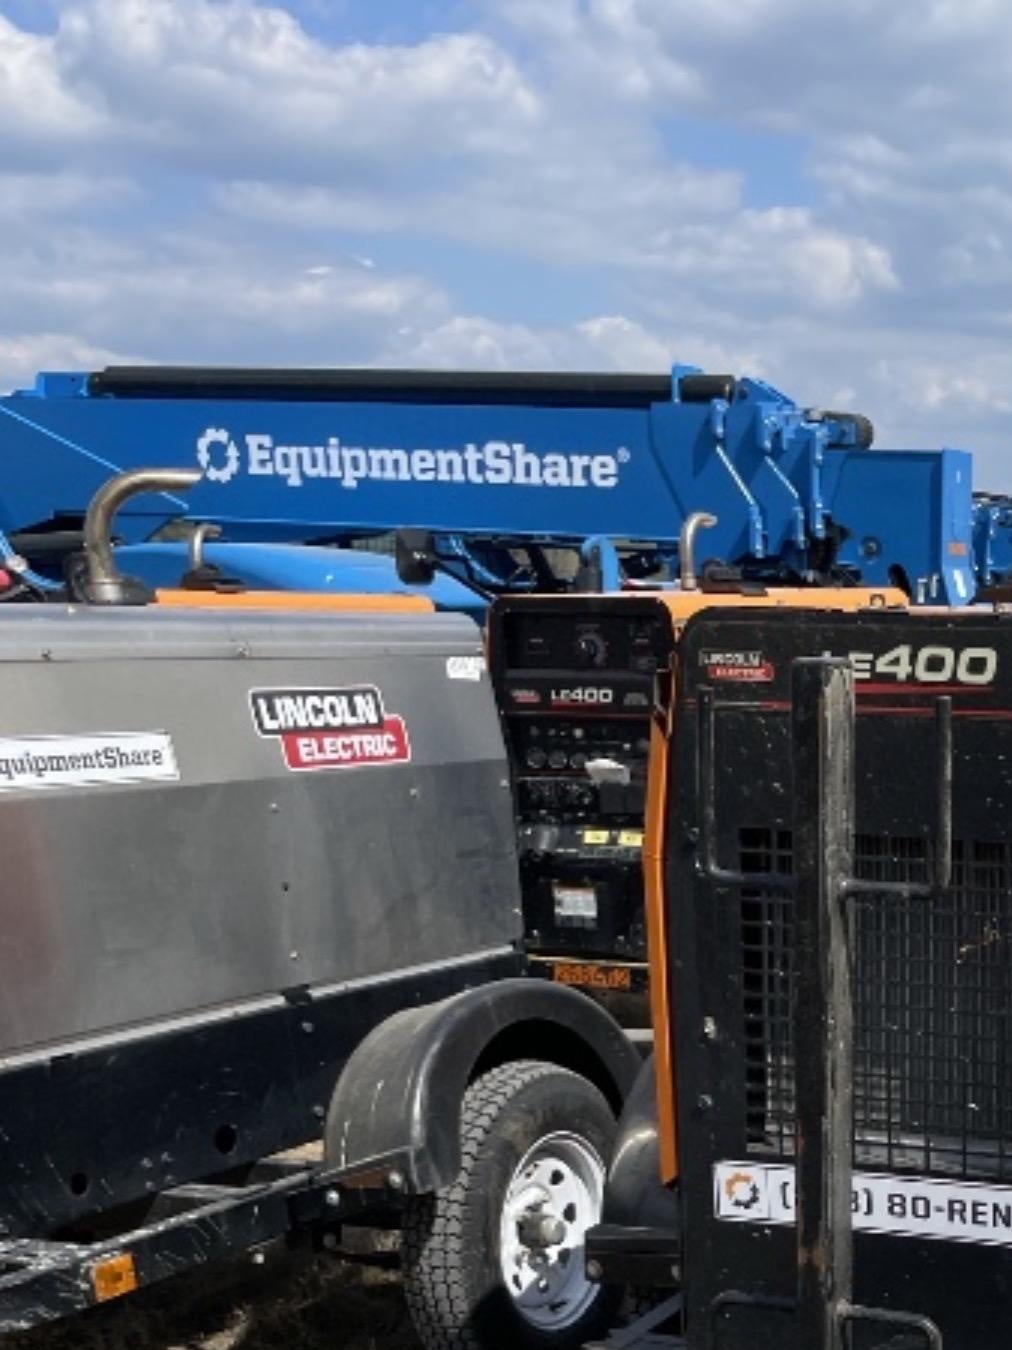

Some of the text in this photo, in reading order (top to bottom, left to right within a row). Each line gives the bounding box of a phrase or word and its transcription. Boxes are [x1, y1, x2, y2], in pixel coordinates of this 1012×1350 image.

[848, 644, 998, 685] E400
[257, 693, 379, 730] LINCOLN
[0, 746, 163, 781] quipmentShare
[296, 734, 398, 763] ELECTRIC
